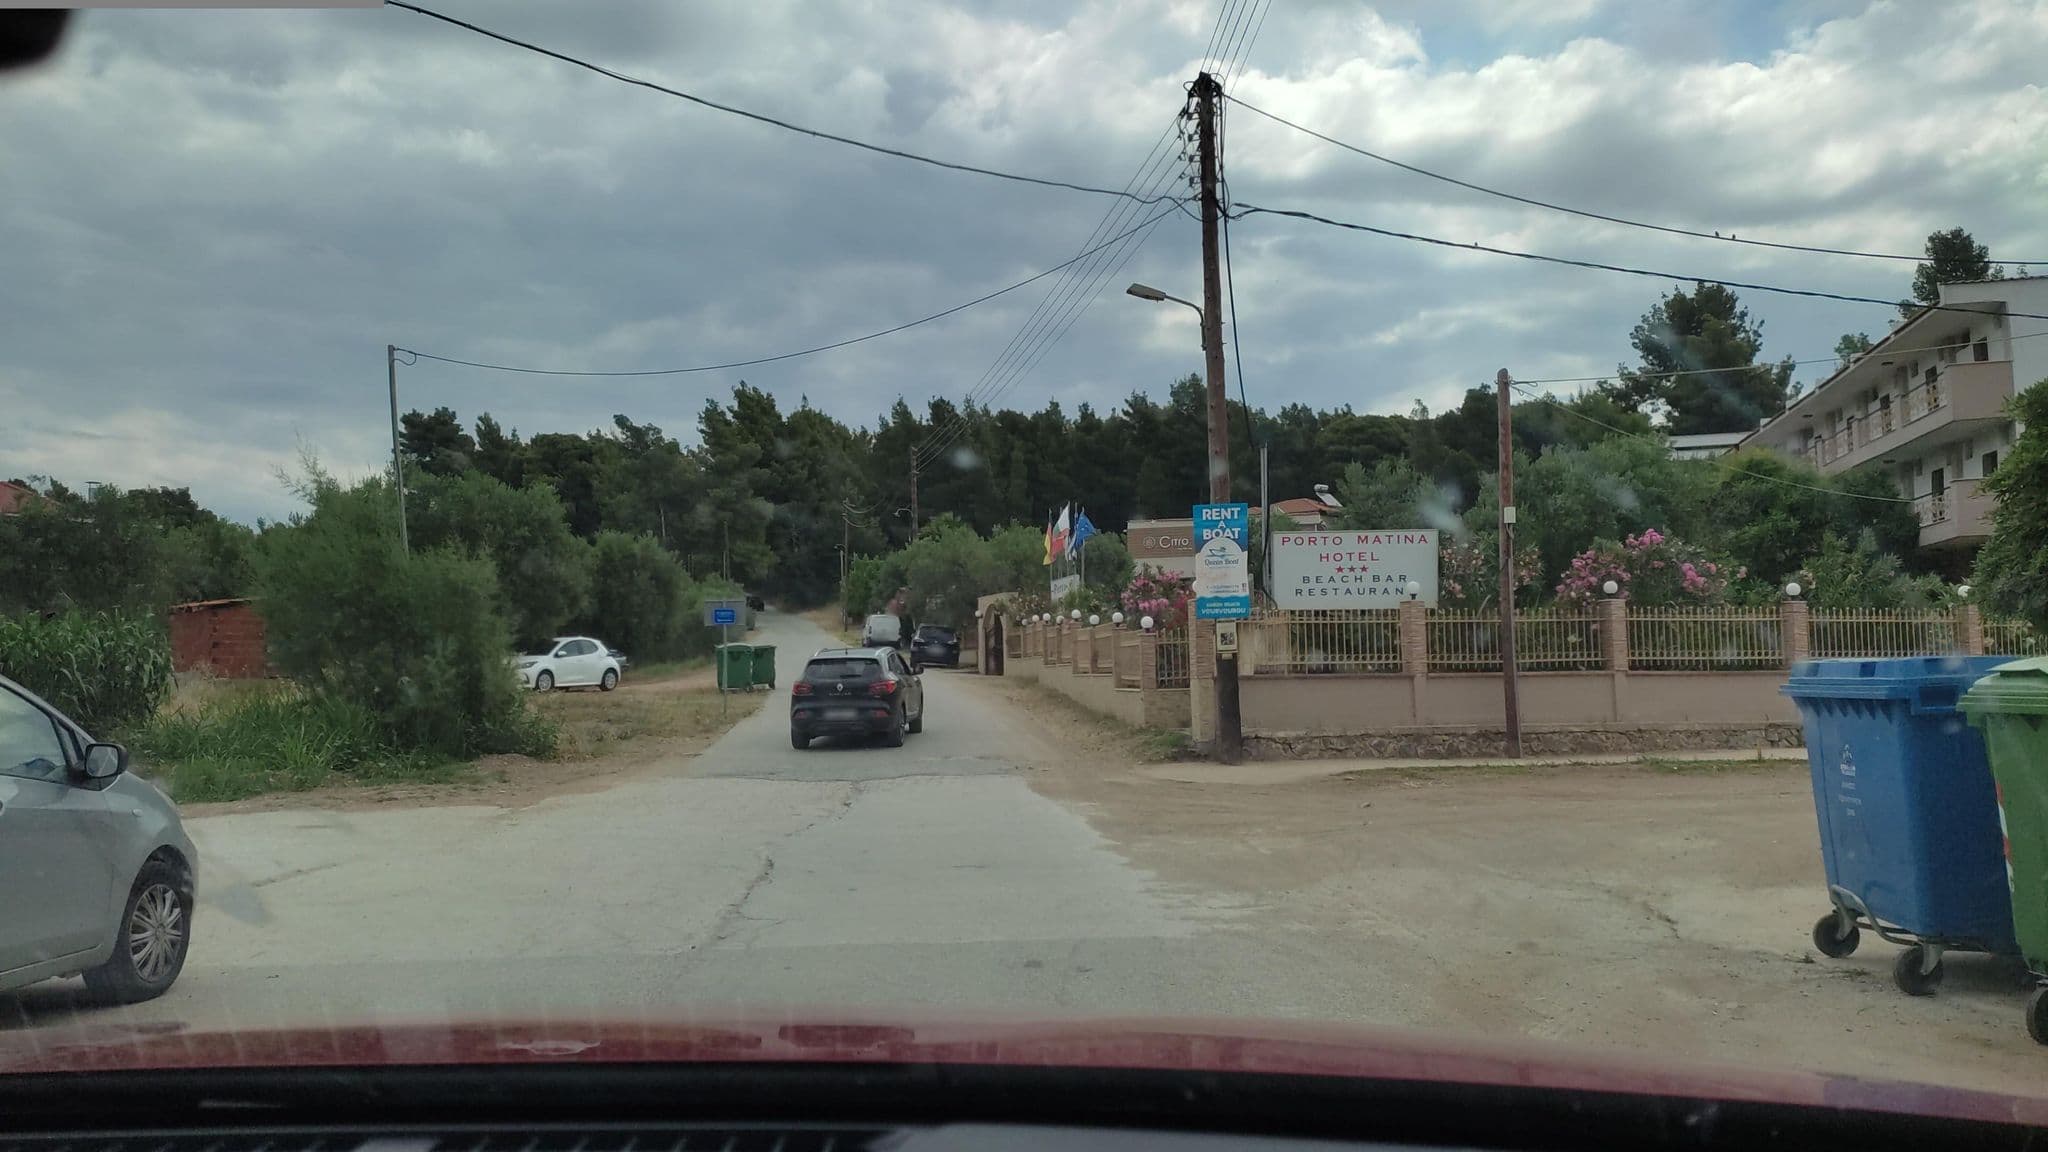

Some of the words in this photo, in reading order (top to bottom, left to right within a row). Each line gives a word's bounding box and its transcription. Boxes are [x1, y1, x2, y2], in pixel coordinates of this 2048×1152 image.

[1202, 507, 1241, 521] RENT
[1217, 520, 1226, 529] A
[1202, 527, 1241, 540] BOAT
[1281, 536, 1343, 546] PORTO
[1357, 534, 1429, 545] MATINA
[1319, 552, 1380, 562] HOTEL
[1302, 575, 1363, 584] BEACH
[1372, 574, 1408, 583] BAR
[1295, 587, 1404, 597] RESTAURAN
